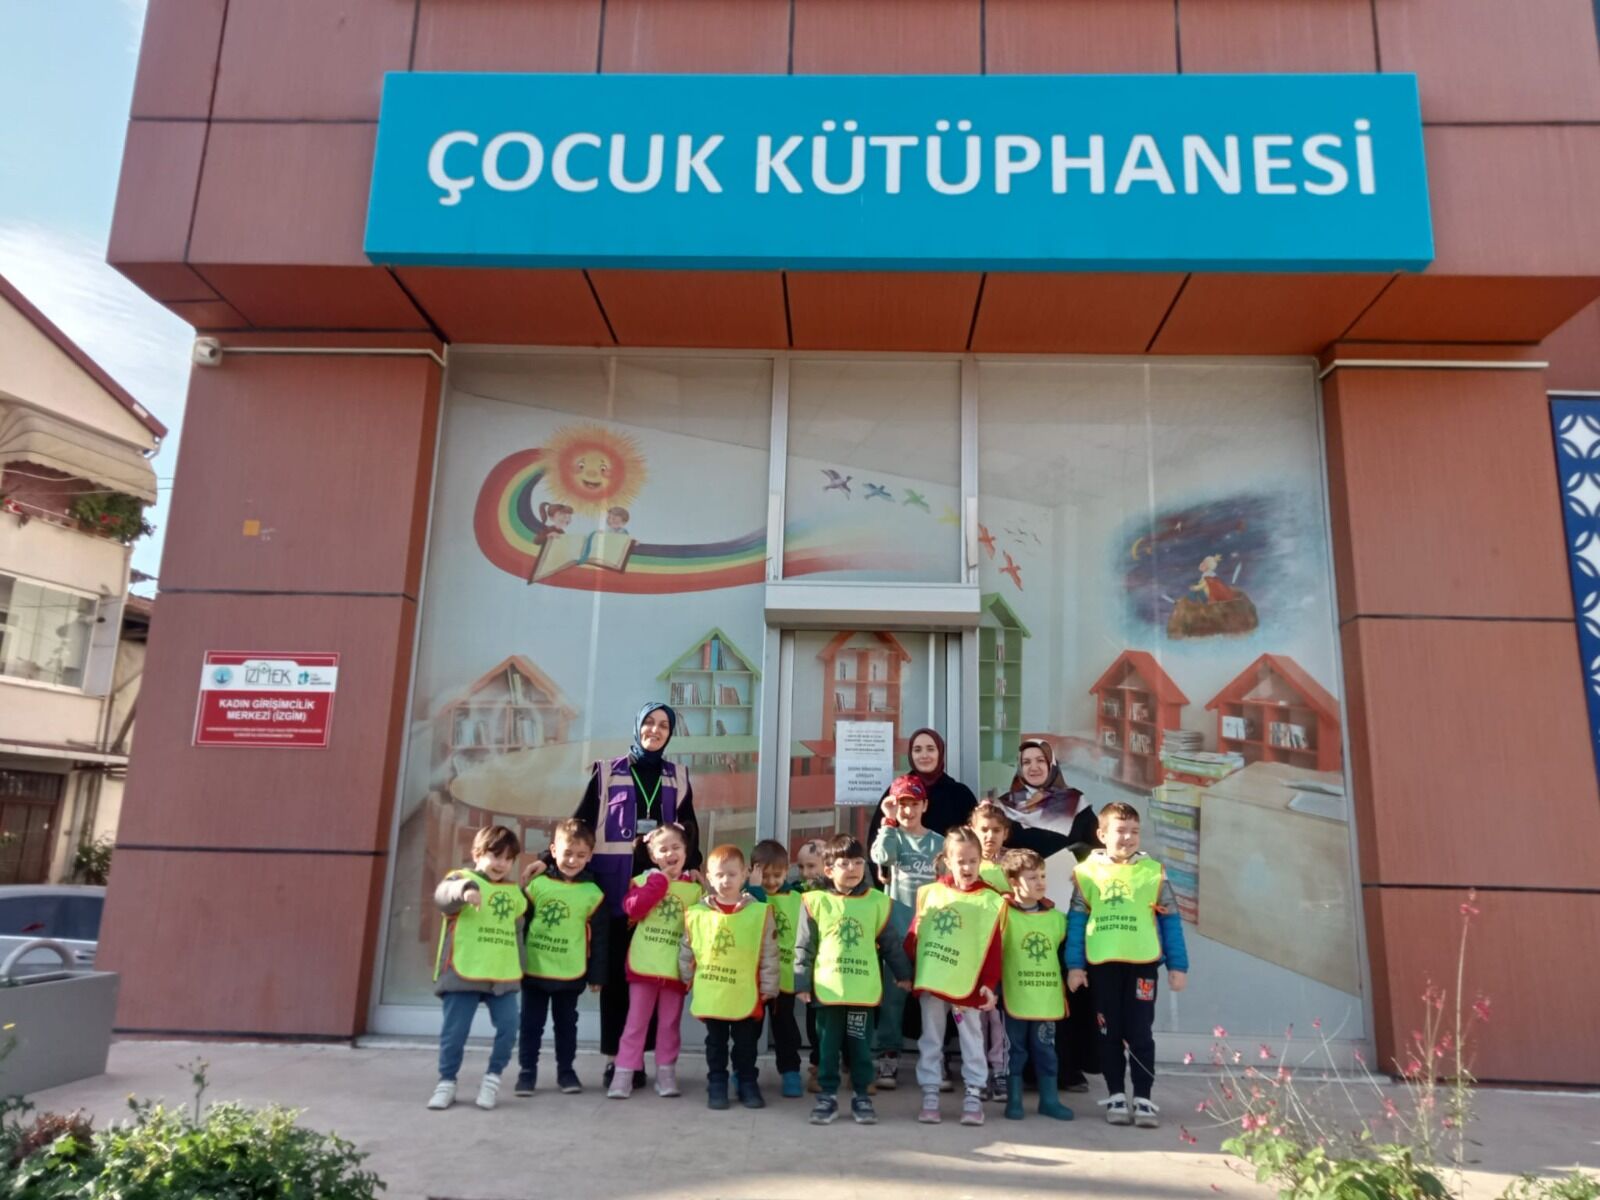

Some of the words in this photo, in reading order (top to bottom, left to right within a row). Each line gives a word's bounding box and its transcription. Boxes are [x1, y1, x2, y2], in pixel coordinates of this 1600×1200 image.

[428, 131, 724, 206] ÇOCUK
[755, 118, 1376, 195] KÜTÜPHANESİ
[218, 699, 249, 708] KADIN
[252, 697, 315, 710] GİRİŞİMCİLİK
[227, 710, 270, 720] MERKEZİ
[272, 711, 307, 722] (İZGİM)
